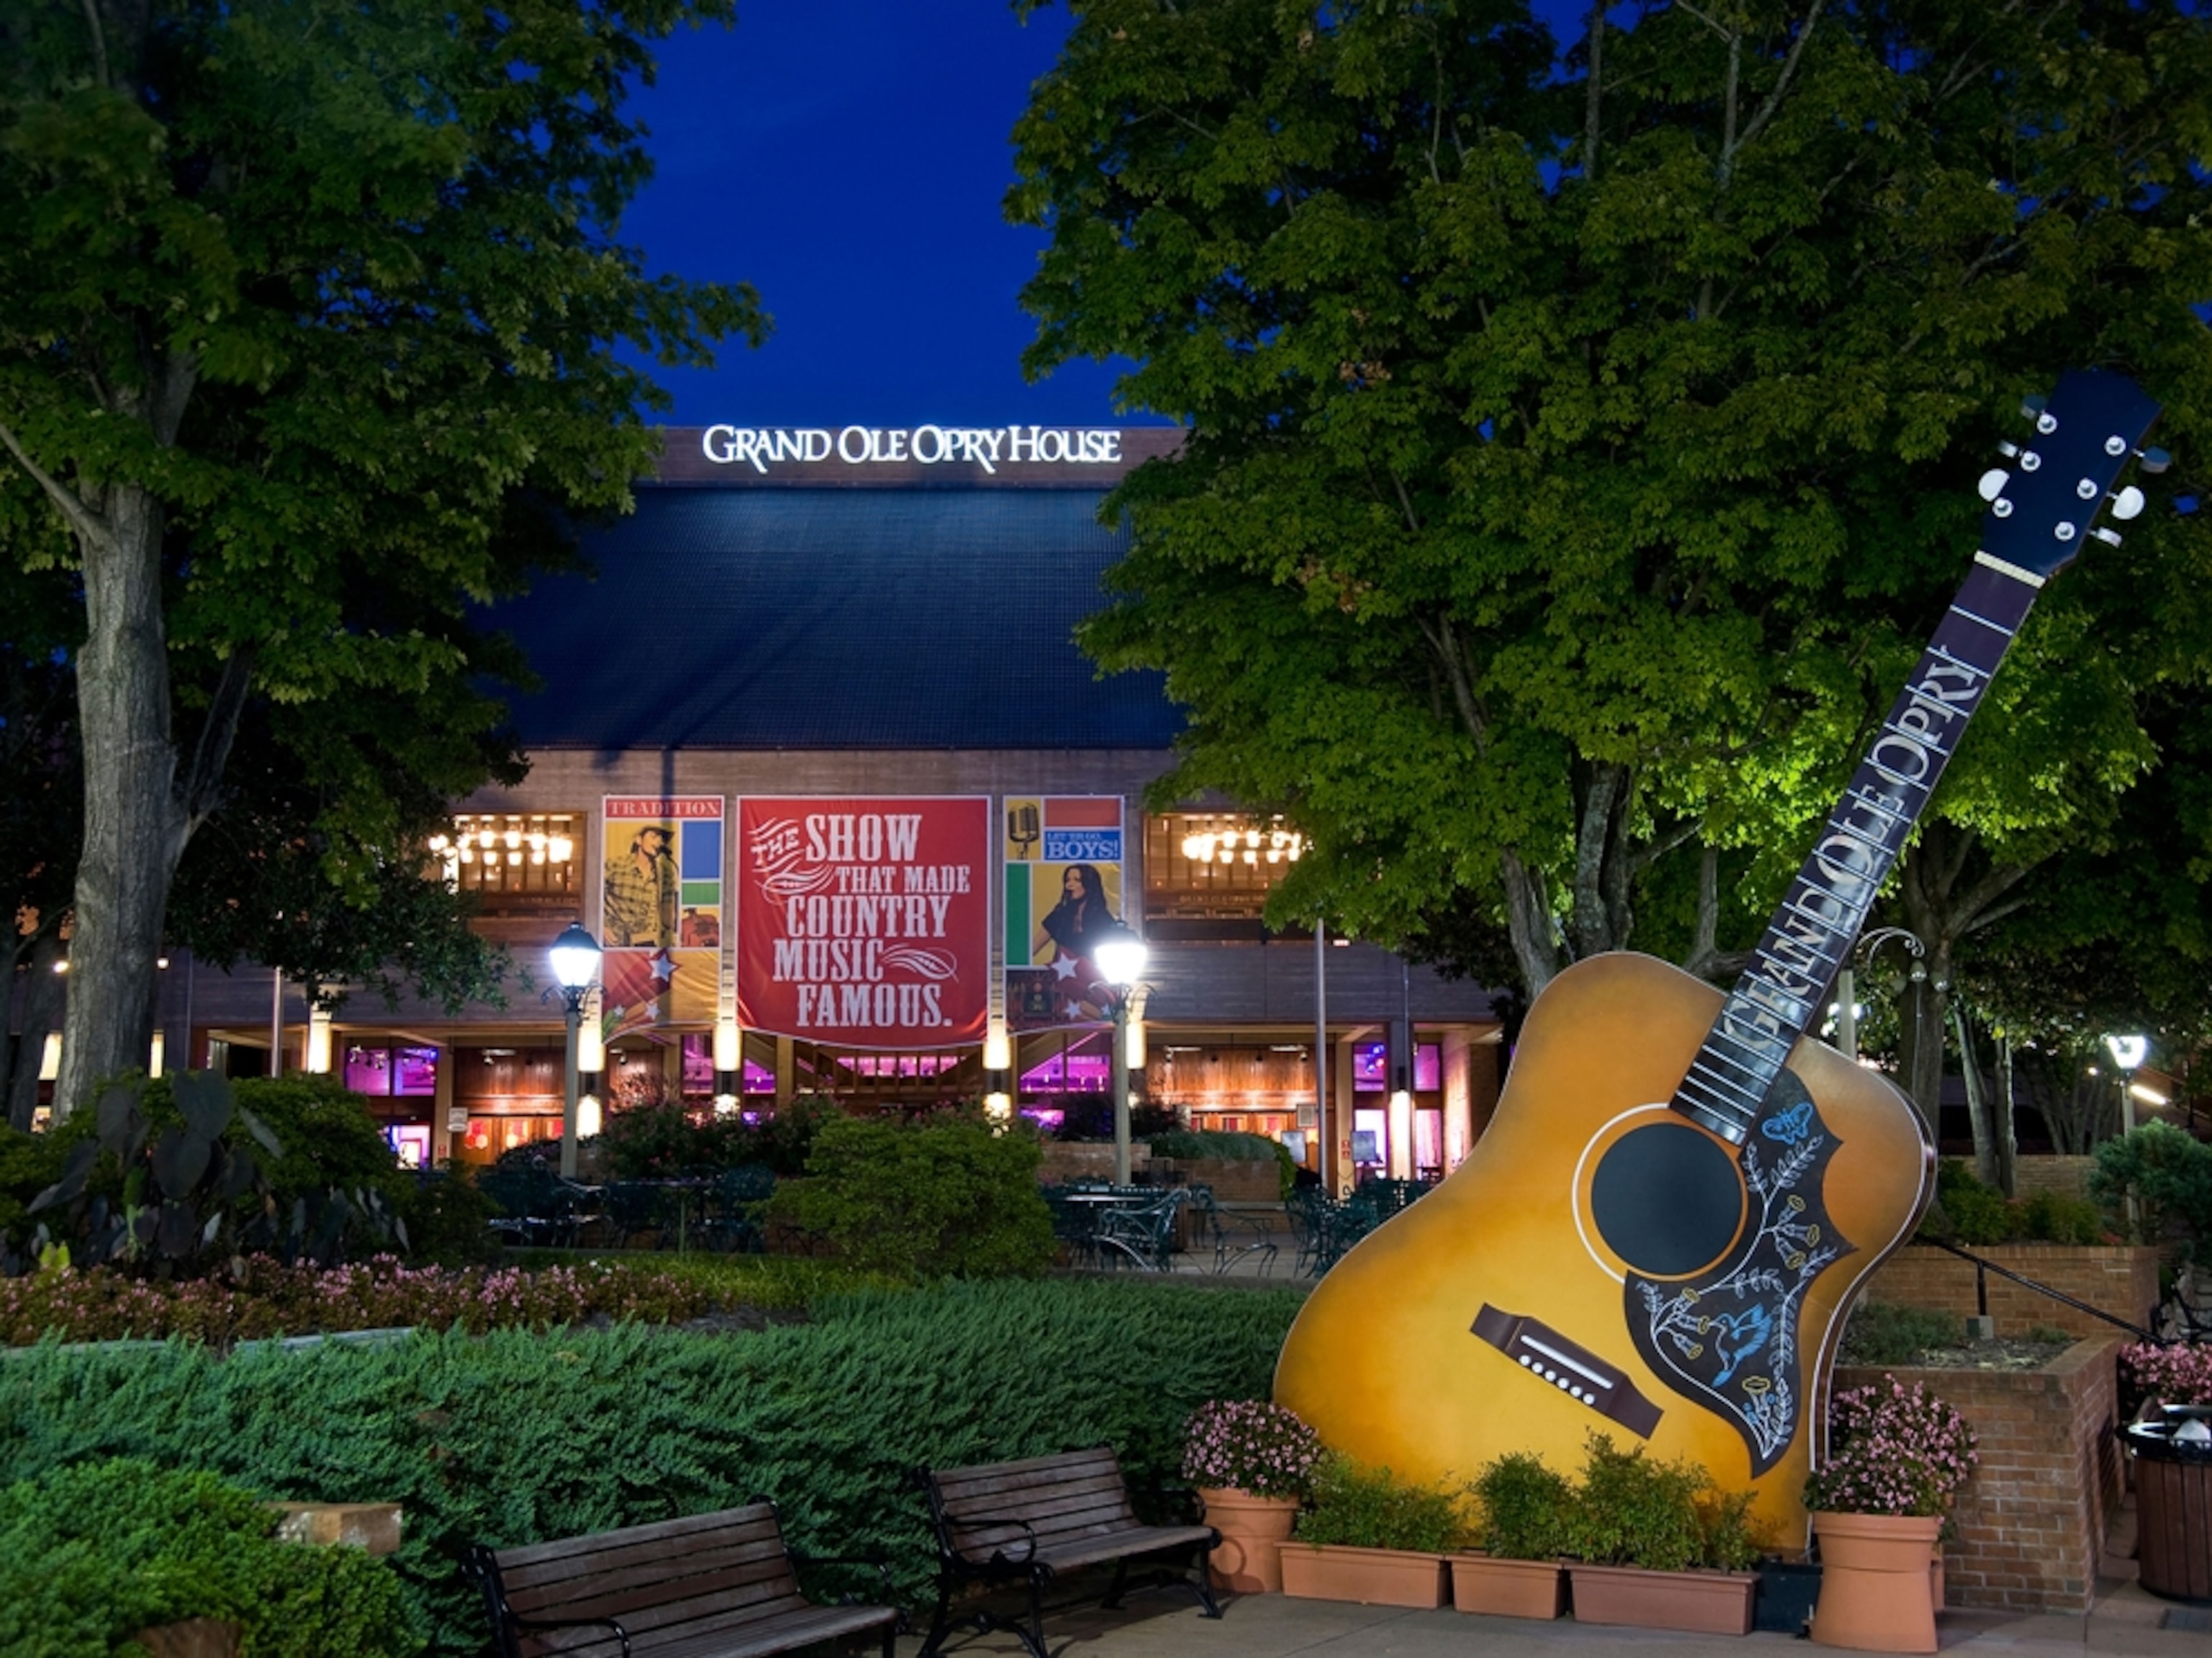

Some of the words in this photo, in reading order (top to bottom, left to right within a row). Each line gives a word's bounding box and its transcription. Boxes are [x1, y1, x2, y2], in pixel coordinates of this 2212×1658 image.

[703, 424, 832, 474] GRAND
[837, 425, 909, 463] OLE
[911, 424, 1006, 474] OPRY
[1008, 426, 1122, 462] HOUSE
[608, 801, 719, 815] TRADITION
[751, 827, 799, 865] THE
[805, 814, 922, 861] SHOW
[1047, 839, 1119, 859] BOYS!
[1724, 888, 1842, 1050] GRAND
[1817, 784, 1905, 883] OLE
[1871, 645, 1979, 785] OPRY
[835, 866, 897, 893] THAT
[904, 865, 971, 893] MADE
[786, 895, 951, 937] COUNTRY
[772, 938, 884, 982] MUSIC
[796, 984, 953, 1027] FAMOUS.
